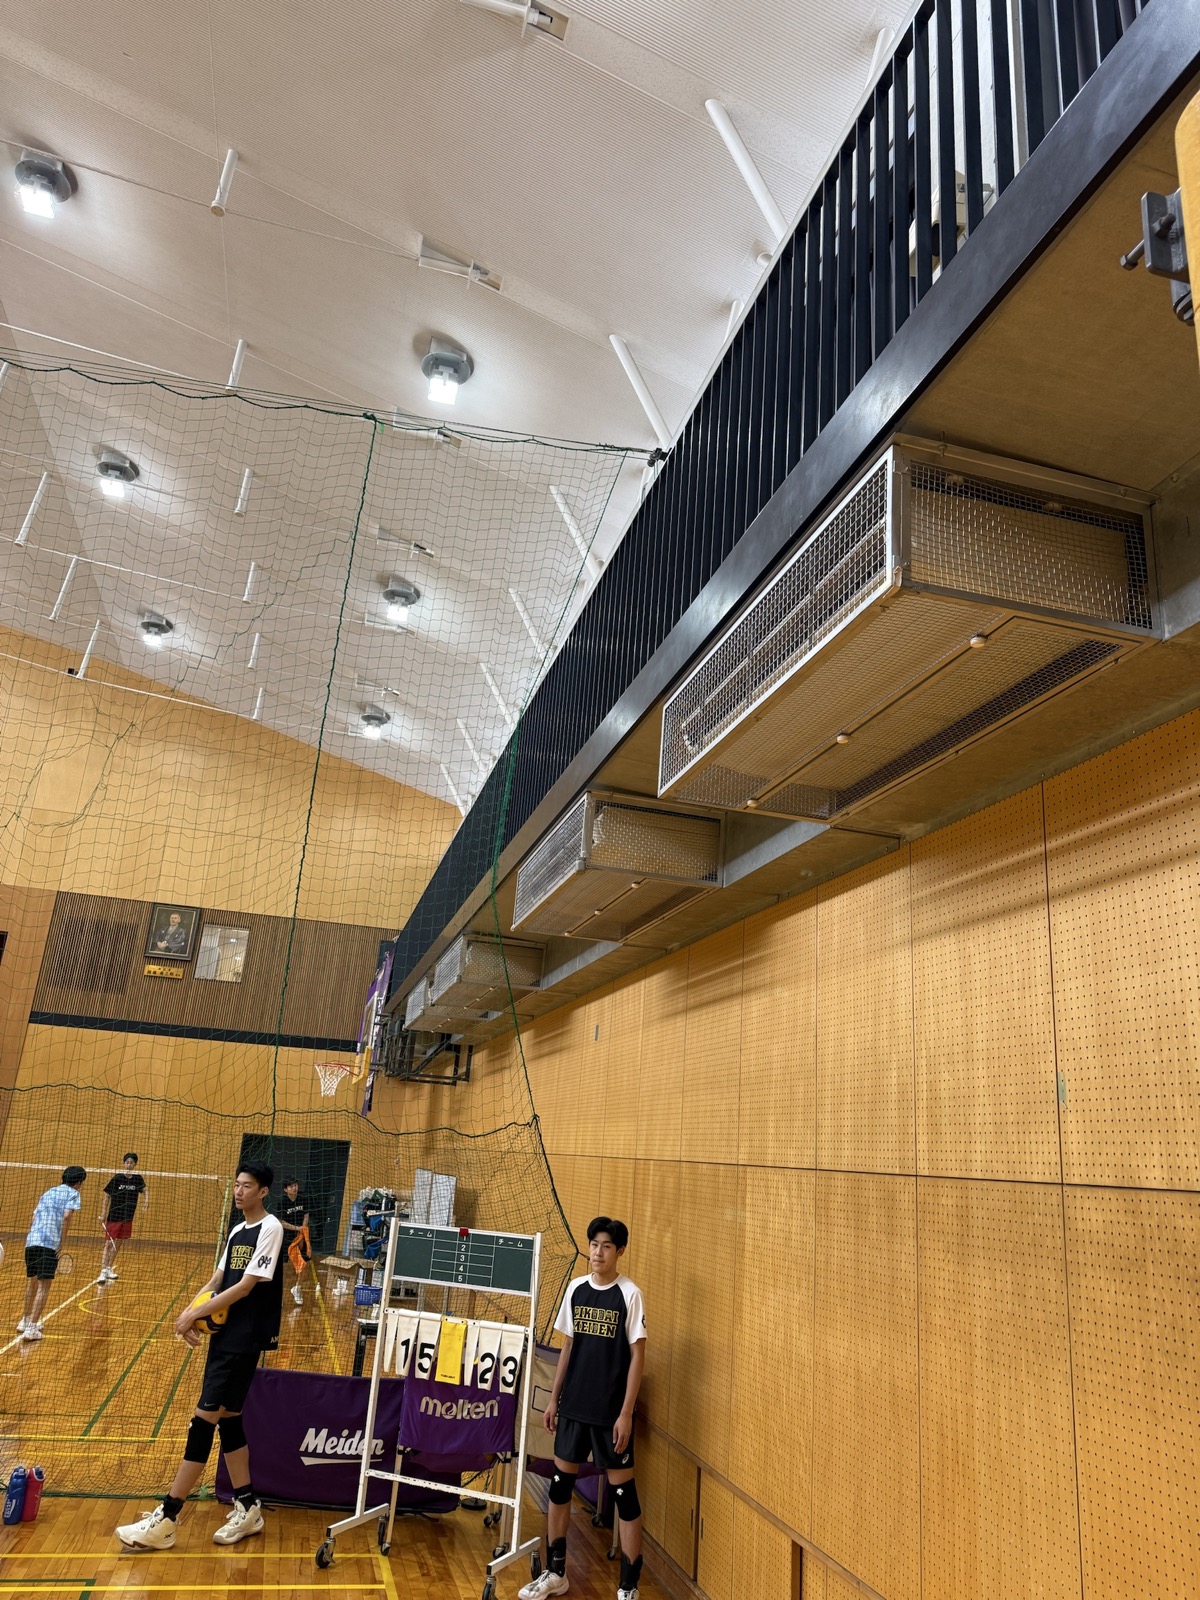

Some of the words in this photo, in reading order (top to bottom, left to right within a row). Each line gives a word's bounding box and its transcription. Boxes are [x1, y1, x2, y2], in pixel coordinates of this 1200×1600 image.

[461, 1244, 466, 1252] 2
[460, 1254, 465, 1262] 3
[458, 1264, 464, 1272] 4
[420, 1396, 499, 1420] molten
[299, 1427, 385, 1456] Meiden
